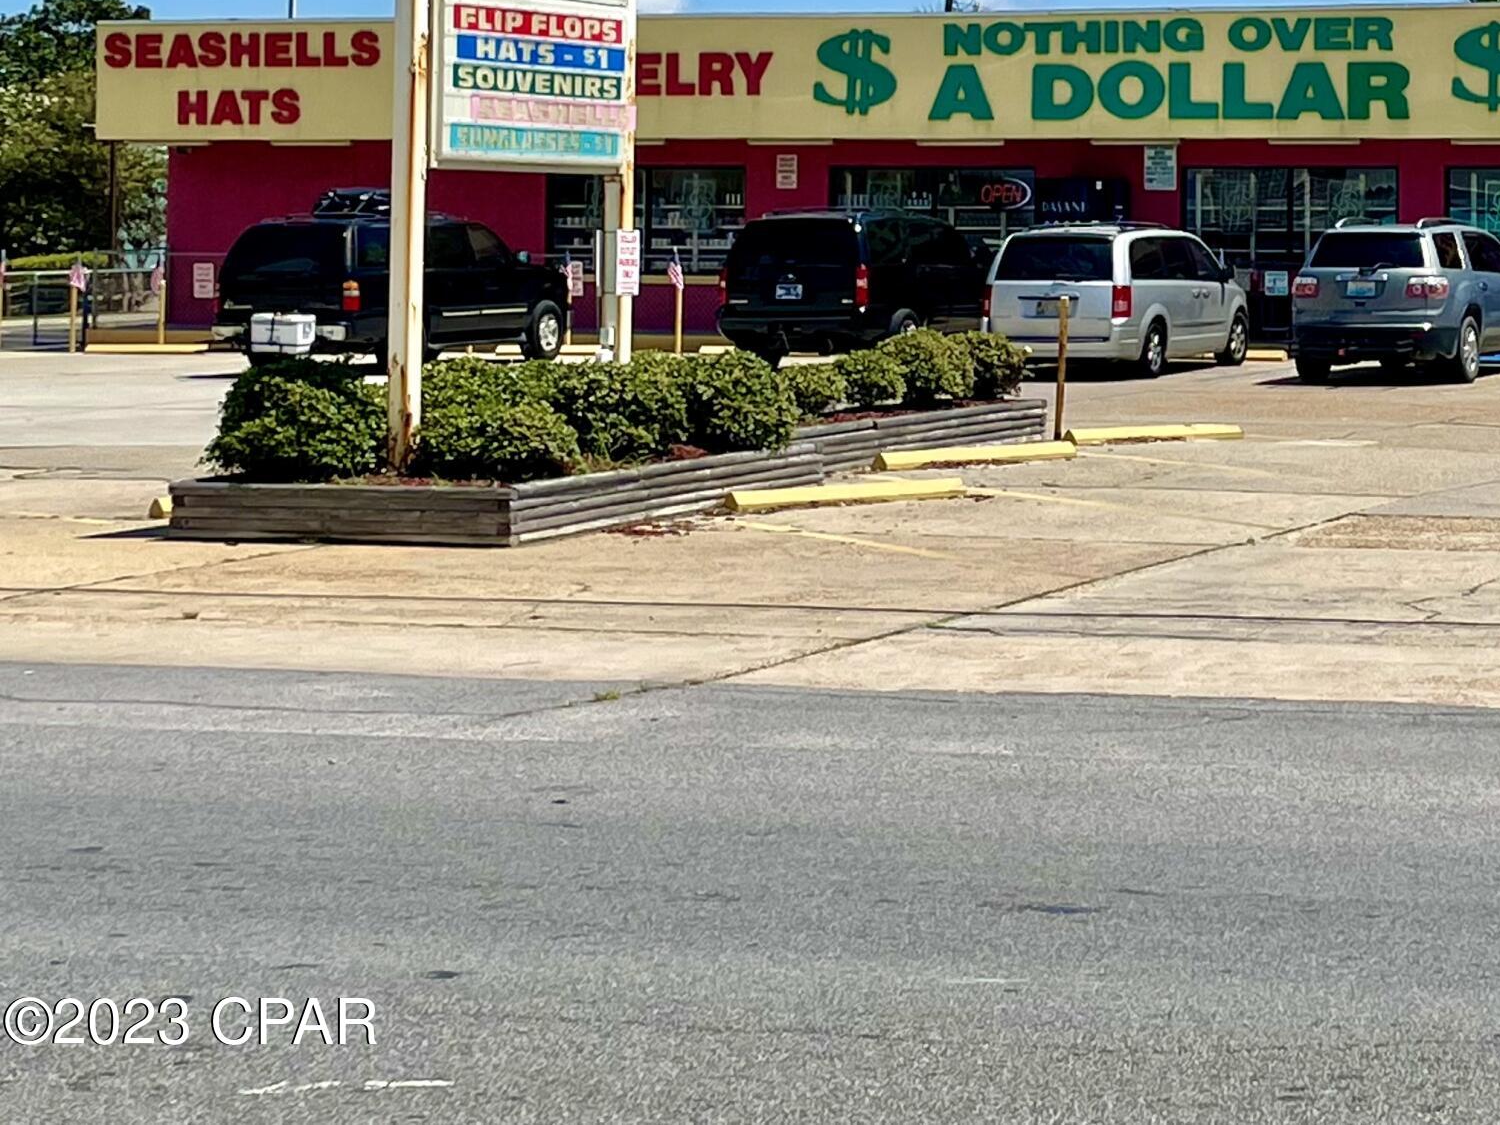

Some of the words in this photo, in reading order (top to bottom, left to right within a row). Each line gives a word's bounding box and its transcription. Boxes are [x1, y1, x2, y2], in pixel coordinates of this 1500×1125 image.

[460, 6, 524, 33] FLIP
[530, 13, 617, 42] FLOPS
[943, 17, 1205, 56] NOTHING
[1227, 16, 1394, 52] OVER
[104, 30, 381, 68] SEASHELLS
[476, 37, 555, 65] HATS
[458, 66, 618, 98] SOUVENIRS
[635, 51, 774, 97] ELRY
[928, 63, 994, 121] A
[1031, 60, 1411, 121] DOLLAR
[177, 89, 301, 125] HATS
[478, 97, 631, 126] SEASHELLS
[981, 183, 1022, 204] OPEN
